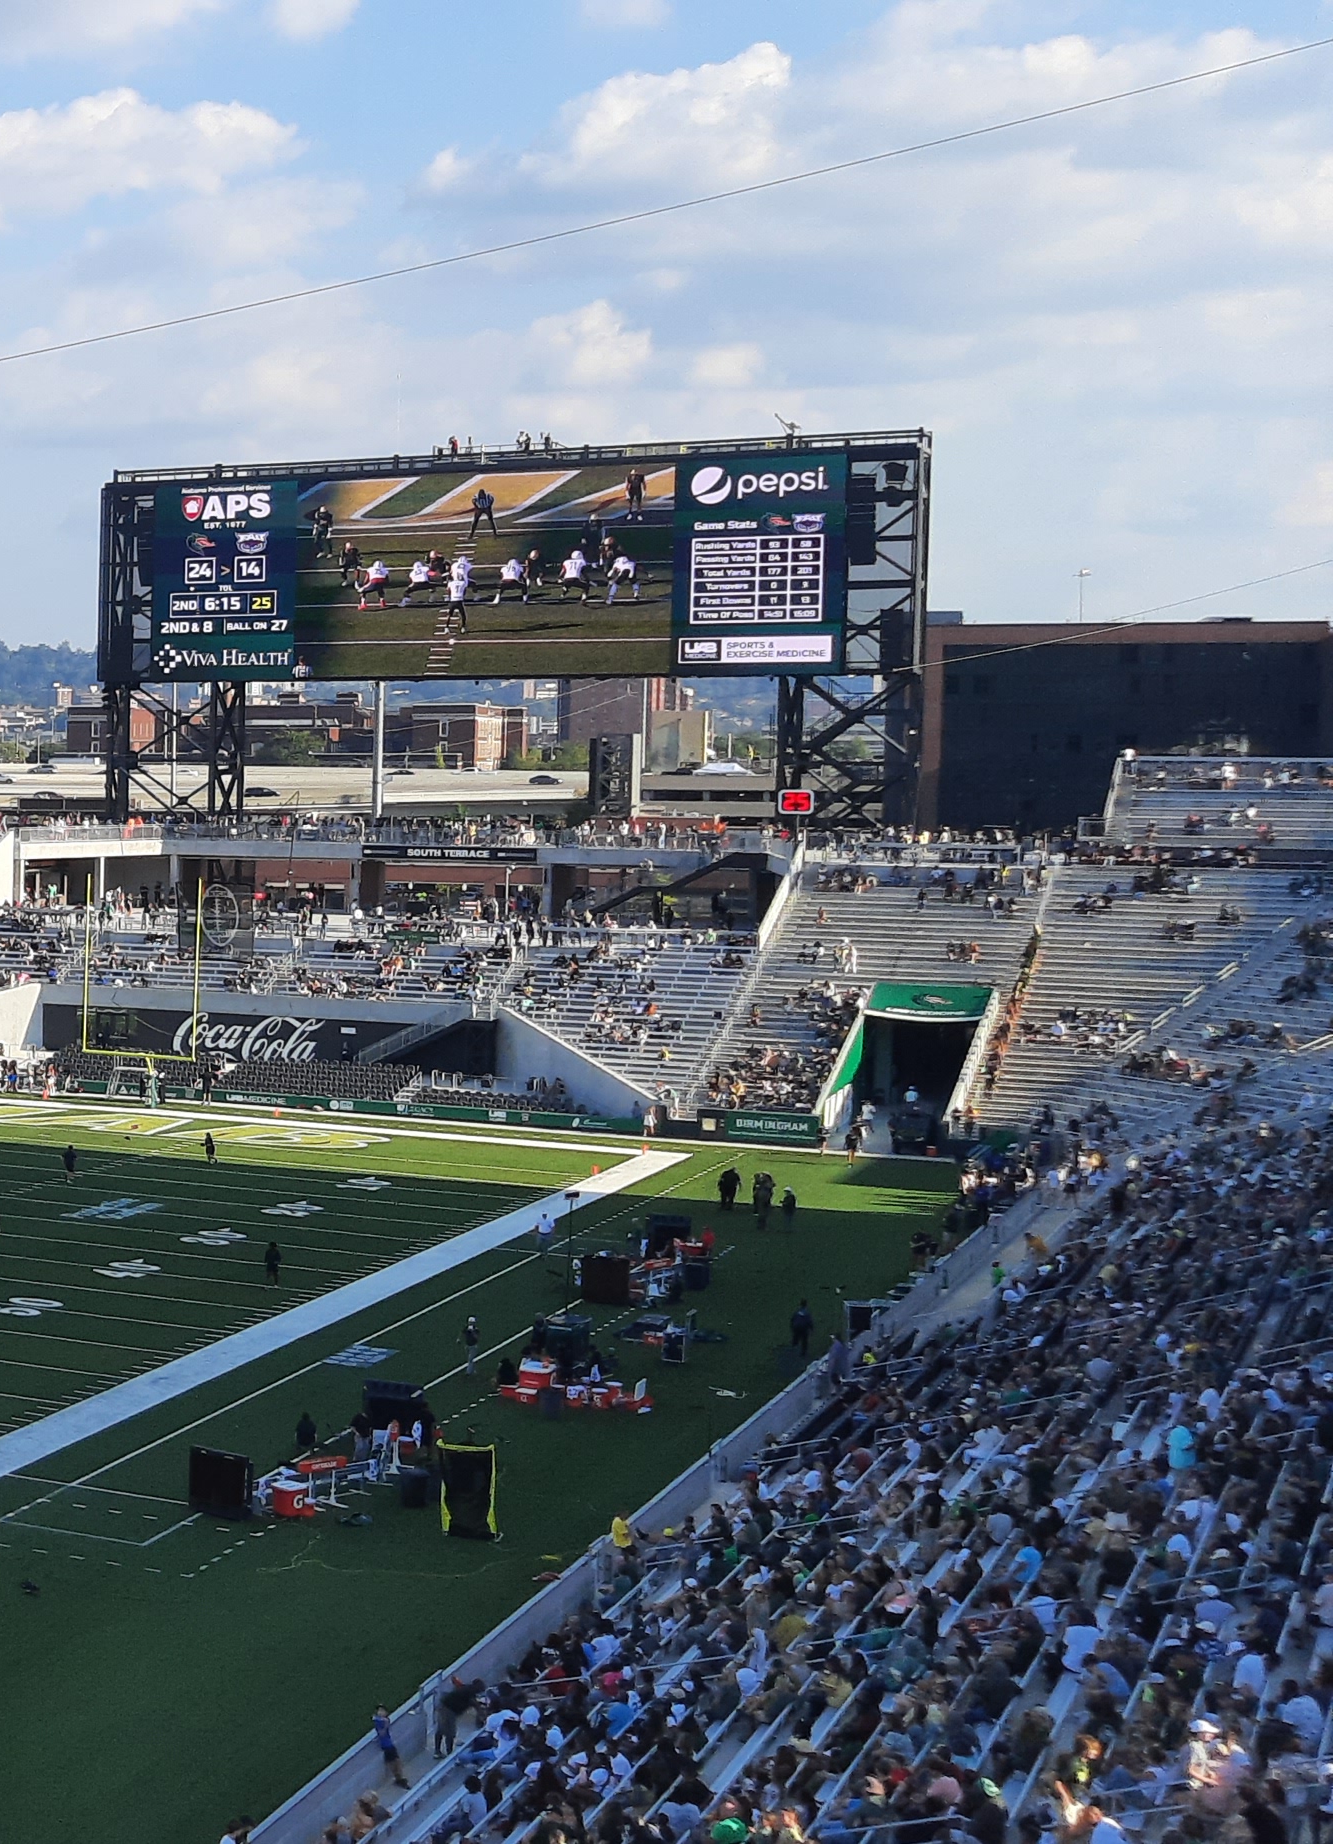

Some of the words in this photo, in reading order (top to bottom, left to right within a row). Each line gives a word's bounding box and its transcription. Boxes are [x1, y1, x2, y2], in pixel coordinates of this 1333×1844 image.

[737, 466, 825, 500] pepsi
[201, 493, 271, 520] APS
[694, 522, 725, 530] Game
[727, 520, 757, 529] Stats
[732, 541, 756, 549] Yards
[188, 563, 212, 578] 24
[240, 561, 260, 576] 14
[703, 569, 724, 577] Total
[173, 601, 197, 611] 2ND
[204, 597, 241, 610] 6:15
[251, 597, 271, 610] 25
[700, 597, 721, 605] First
[697, 611, 719, 619] Time
[160, 622, 189, 634] 2ND
[191, 623, 200, 632] &
[202, 621, 213, 632] 8
[227, 622, 251, 630] BALL
[253, 622, 267, 630] ON
[270, 619, 288, 631] 27
[181, 650, 217, 666] VIVA
[221, 649, 288, 665] HEALTH
[726, 650, 774, 658] EXERCISE
[776, 649, 826, 658] MEDICINE
[783, 792, 811, 811] 25
[406, 848, 441, 857] SOUTH
[443, 849, 491, 858] TERRACE
[172, 1012, 326, 1063] Coca-Cola
[736, 1118, 808, 1131] BIRMINGHAM
[93, 1260, 162, 1278] 40
[293, 1494, 304, 1509] G
